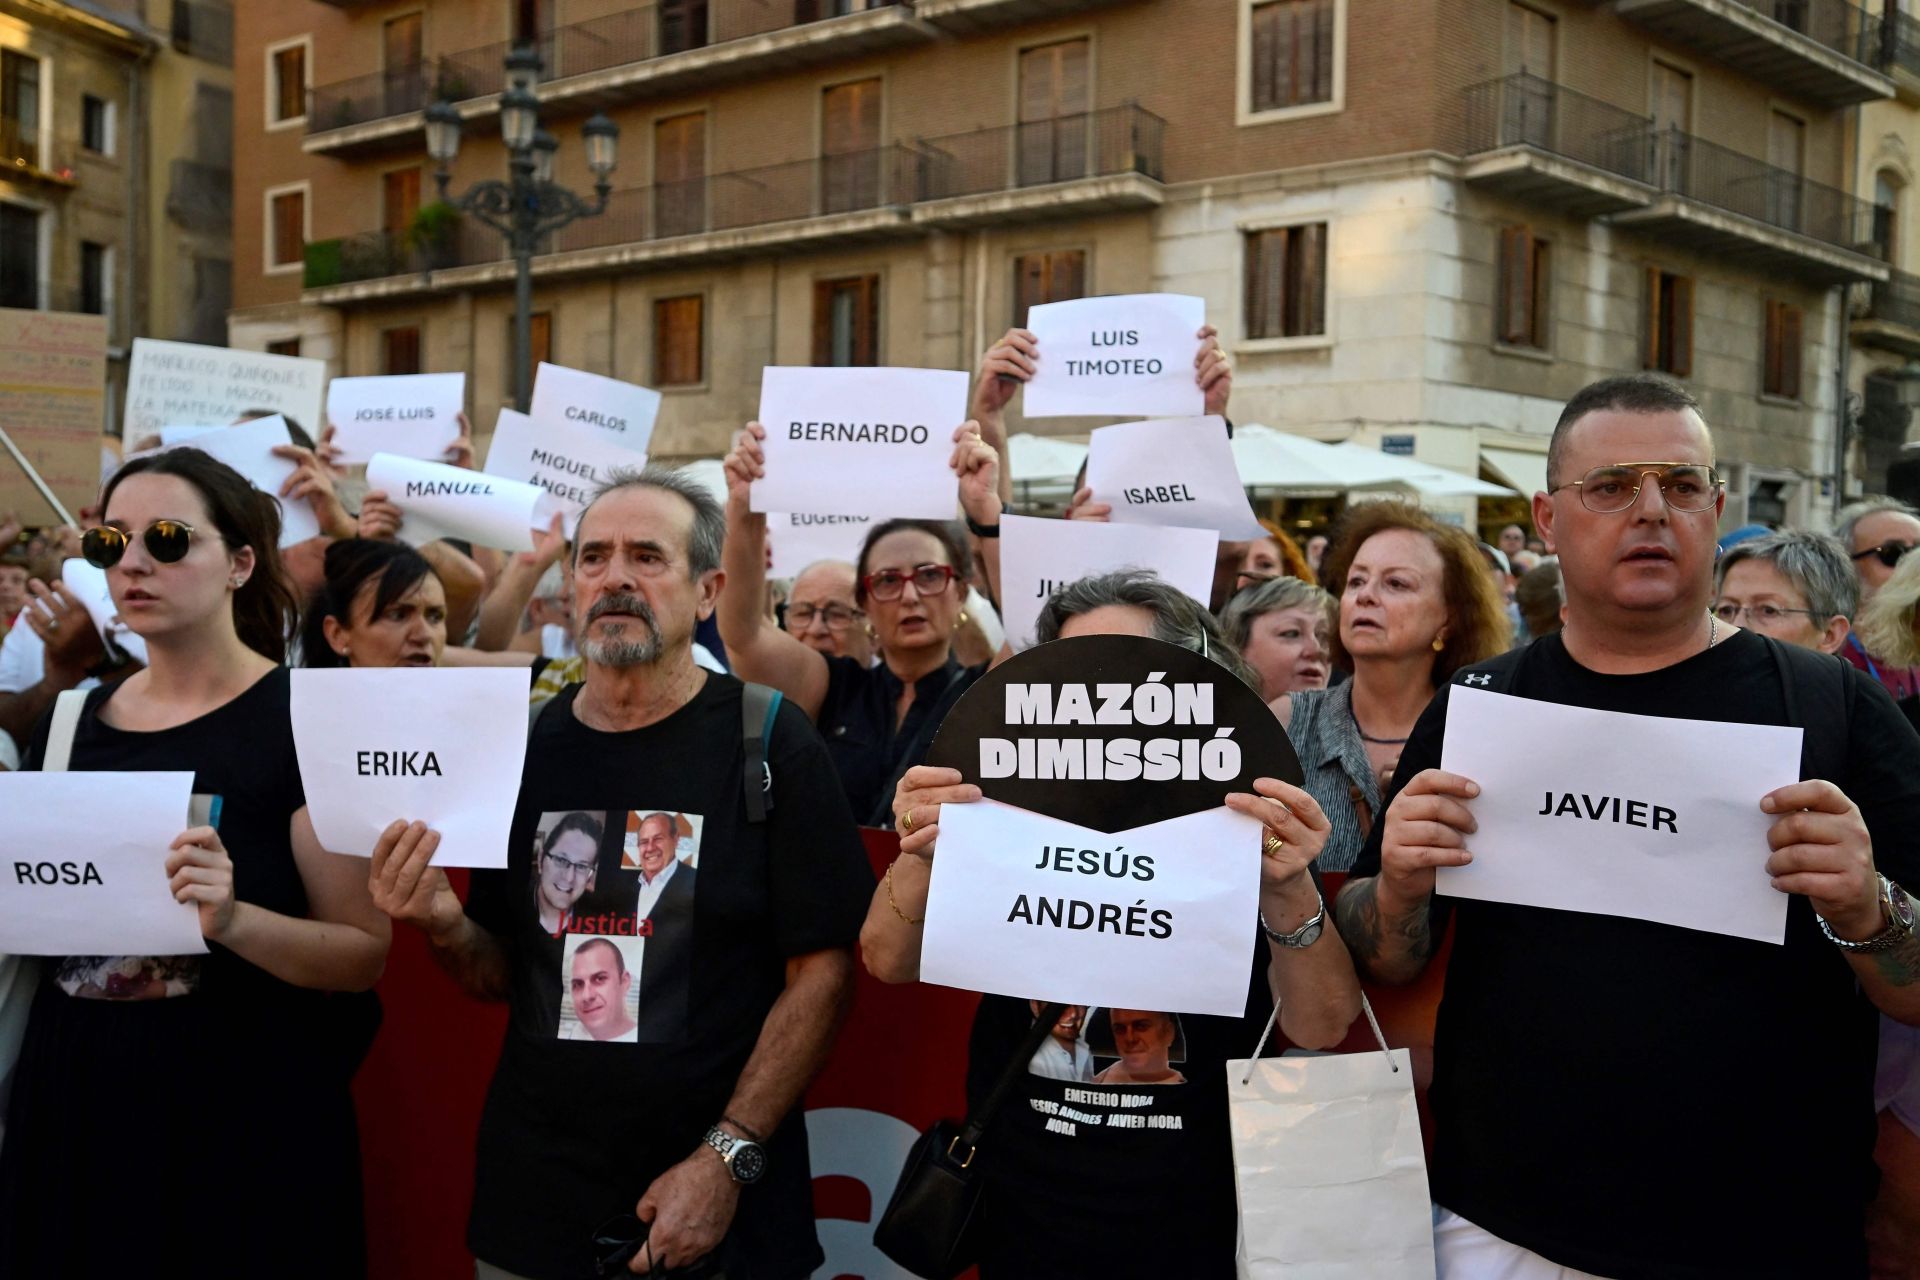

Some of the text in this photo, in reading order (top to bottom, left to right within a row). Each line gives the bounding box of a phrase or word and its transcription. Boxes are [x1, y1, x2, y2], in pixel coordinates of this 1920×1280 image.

[1091, 330, 1139, 347] LUIS
[1066, 358, 1163, 376] TIMOTEO
[355, 406, 436, 422] JOSÉ LUIS
[564, 405, 627, 433] CARLOS
[788, 421, 929, 445] BERNARDO
[530, 447, 600, 482] MIGUEL
[406, 480, 495, 498] MANUEL
[528, 472, 587, 505] ÁNGEL
[1123, 484, 1196, 505] ISABEL
[1005, 671, 1214, 726] MAZÓN
[356, 751, 443, 777] ERIKA
[979, 727, 1242, 782] DIMISSIÓ
[1538, 791, 1679, 834] JAVIER
[13, 861, 104, 886] ROSA
[1035, 845, 1156, 882] JESÚS
[552, 911, 654, 938] Justicia
[1006, 894, 1174, 940] ANDRÉS
[1064, 1088, 1154, 1108] EMETERIO MORA
[1045, 1118, 1077, 1137] MORA
[1058, 1106, 1102, 1125] ANDRES
[1106, 1114, 1183, 1130] JAVIER MORA
